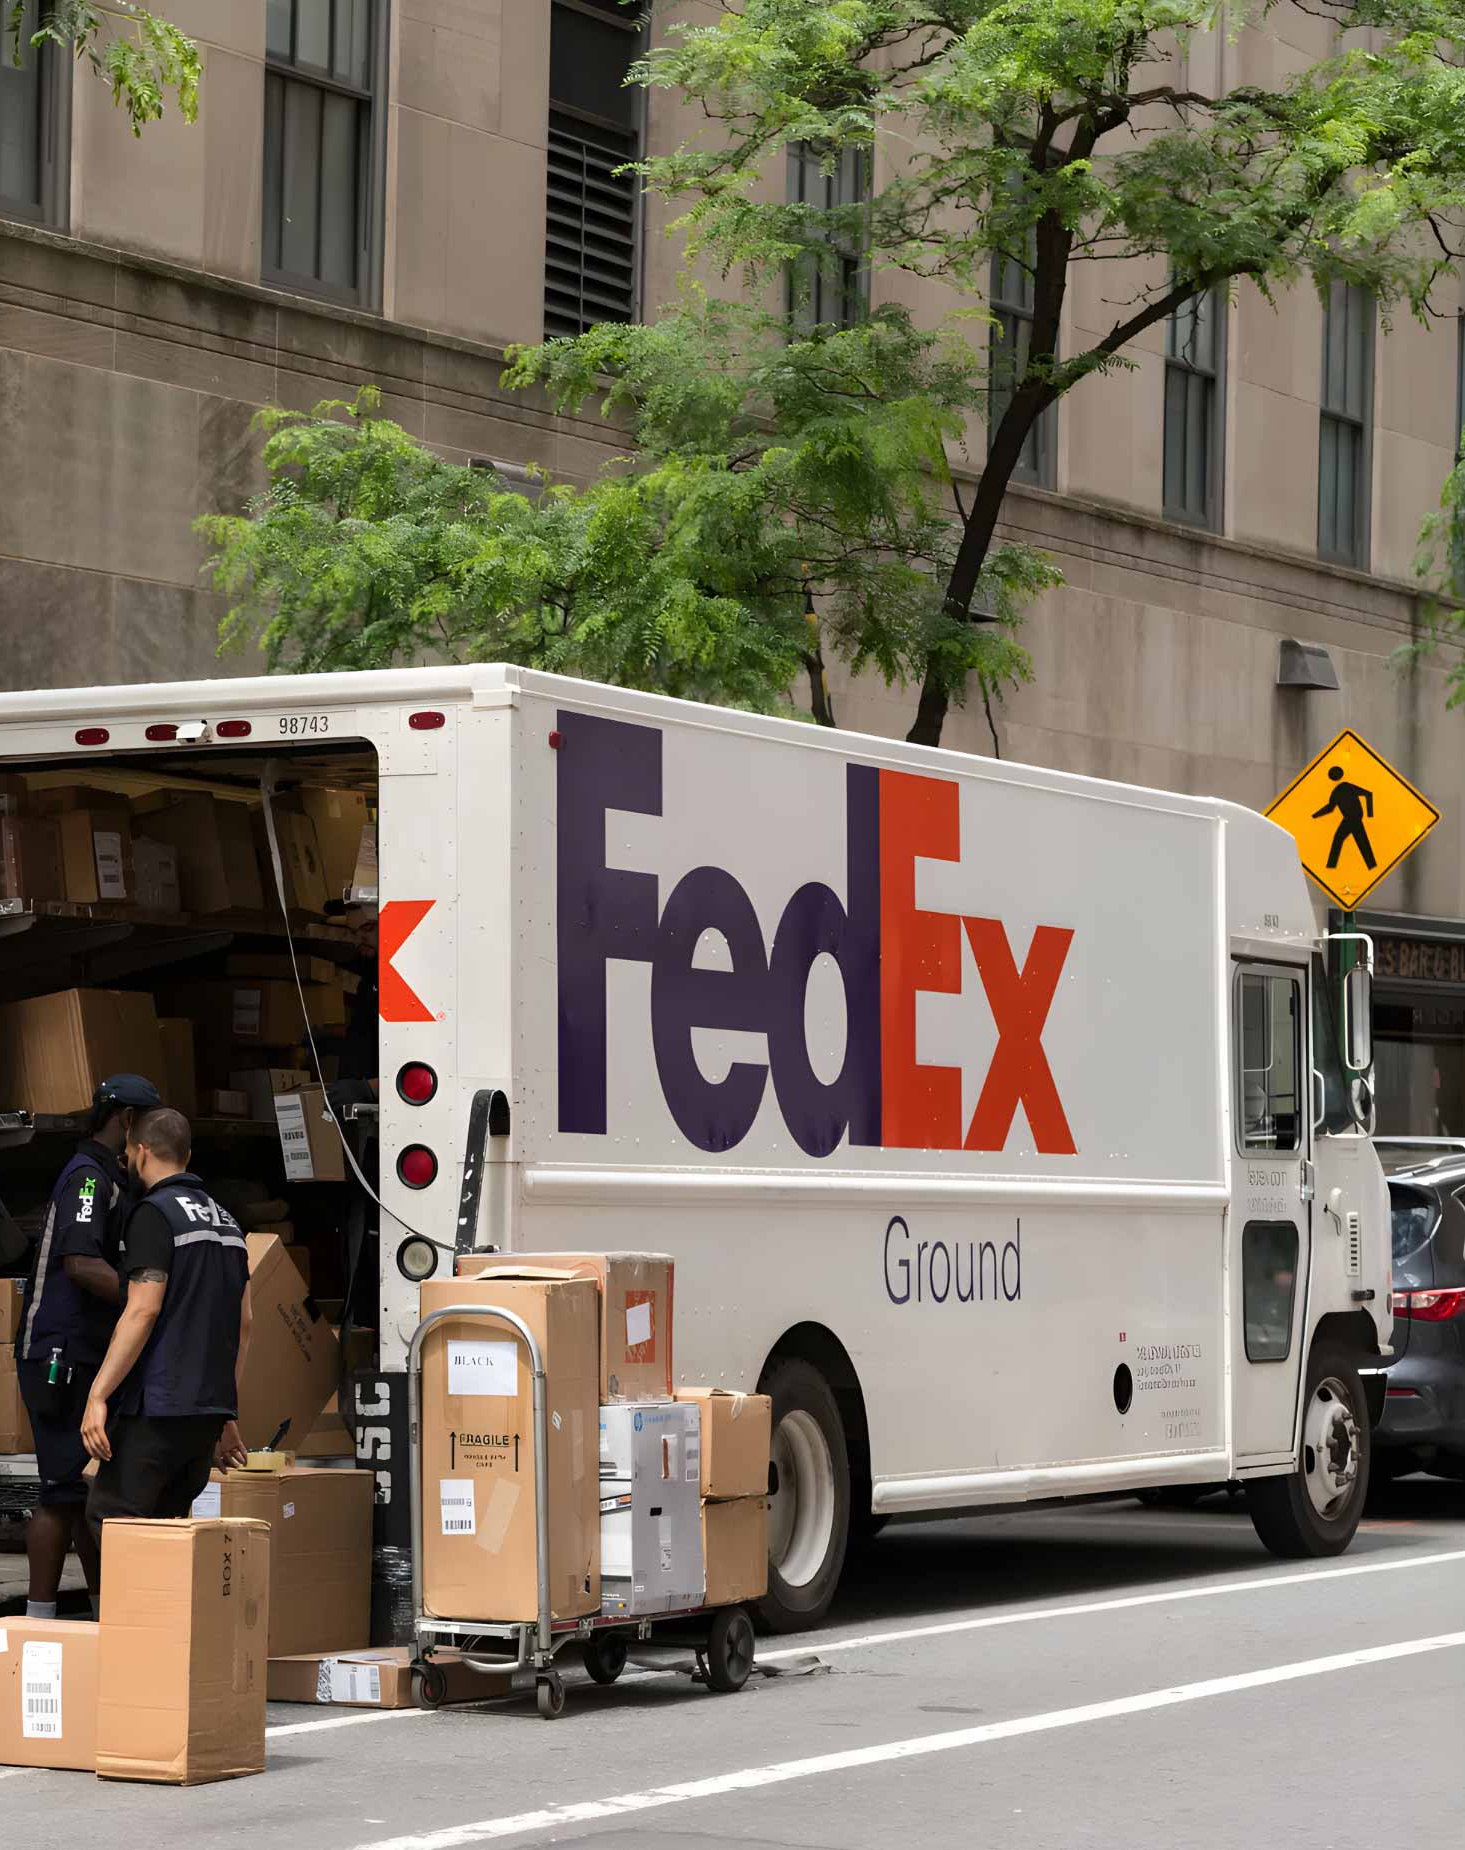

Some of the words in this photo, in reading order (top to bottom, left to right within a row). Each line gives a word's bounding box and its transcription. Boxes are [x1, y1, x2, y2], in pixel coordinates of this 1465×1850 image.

[279, 715, 329, 735] 98743
[556, 709, 1078, 1159] FedEx
[76, 1177, 97, 1223] FedEx
[884, 1215, 1021, 1305] Ground
[454, 1356, 495, 1366] BLACK
[459, 1433, 509, 1446] FRAGILE
[223, 1552, 232, 1597] BOX
